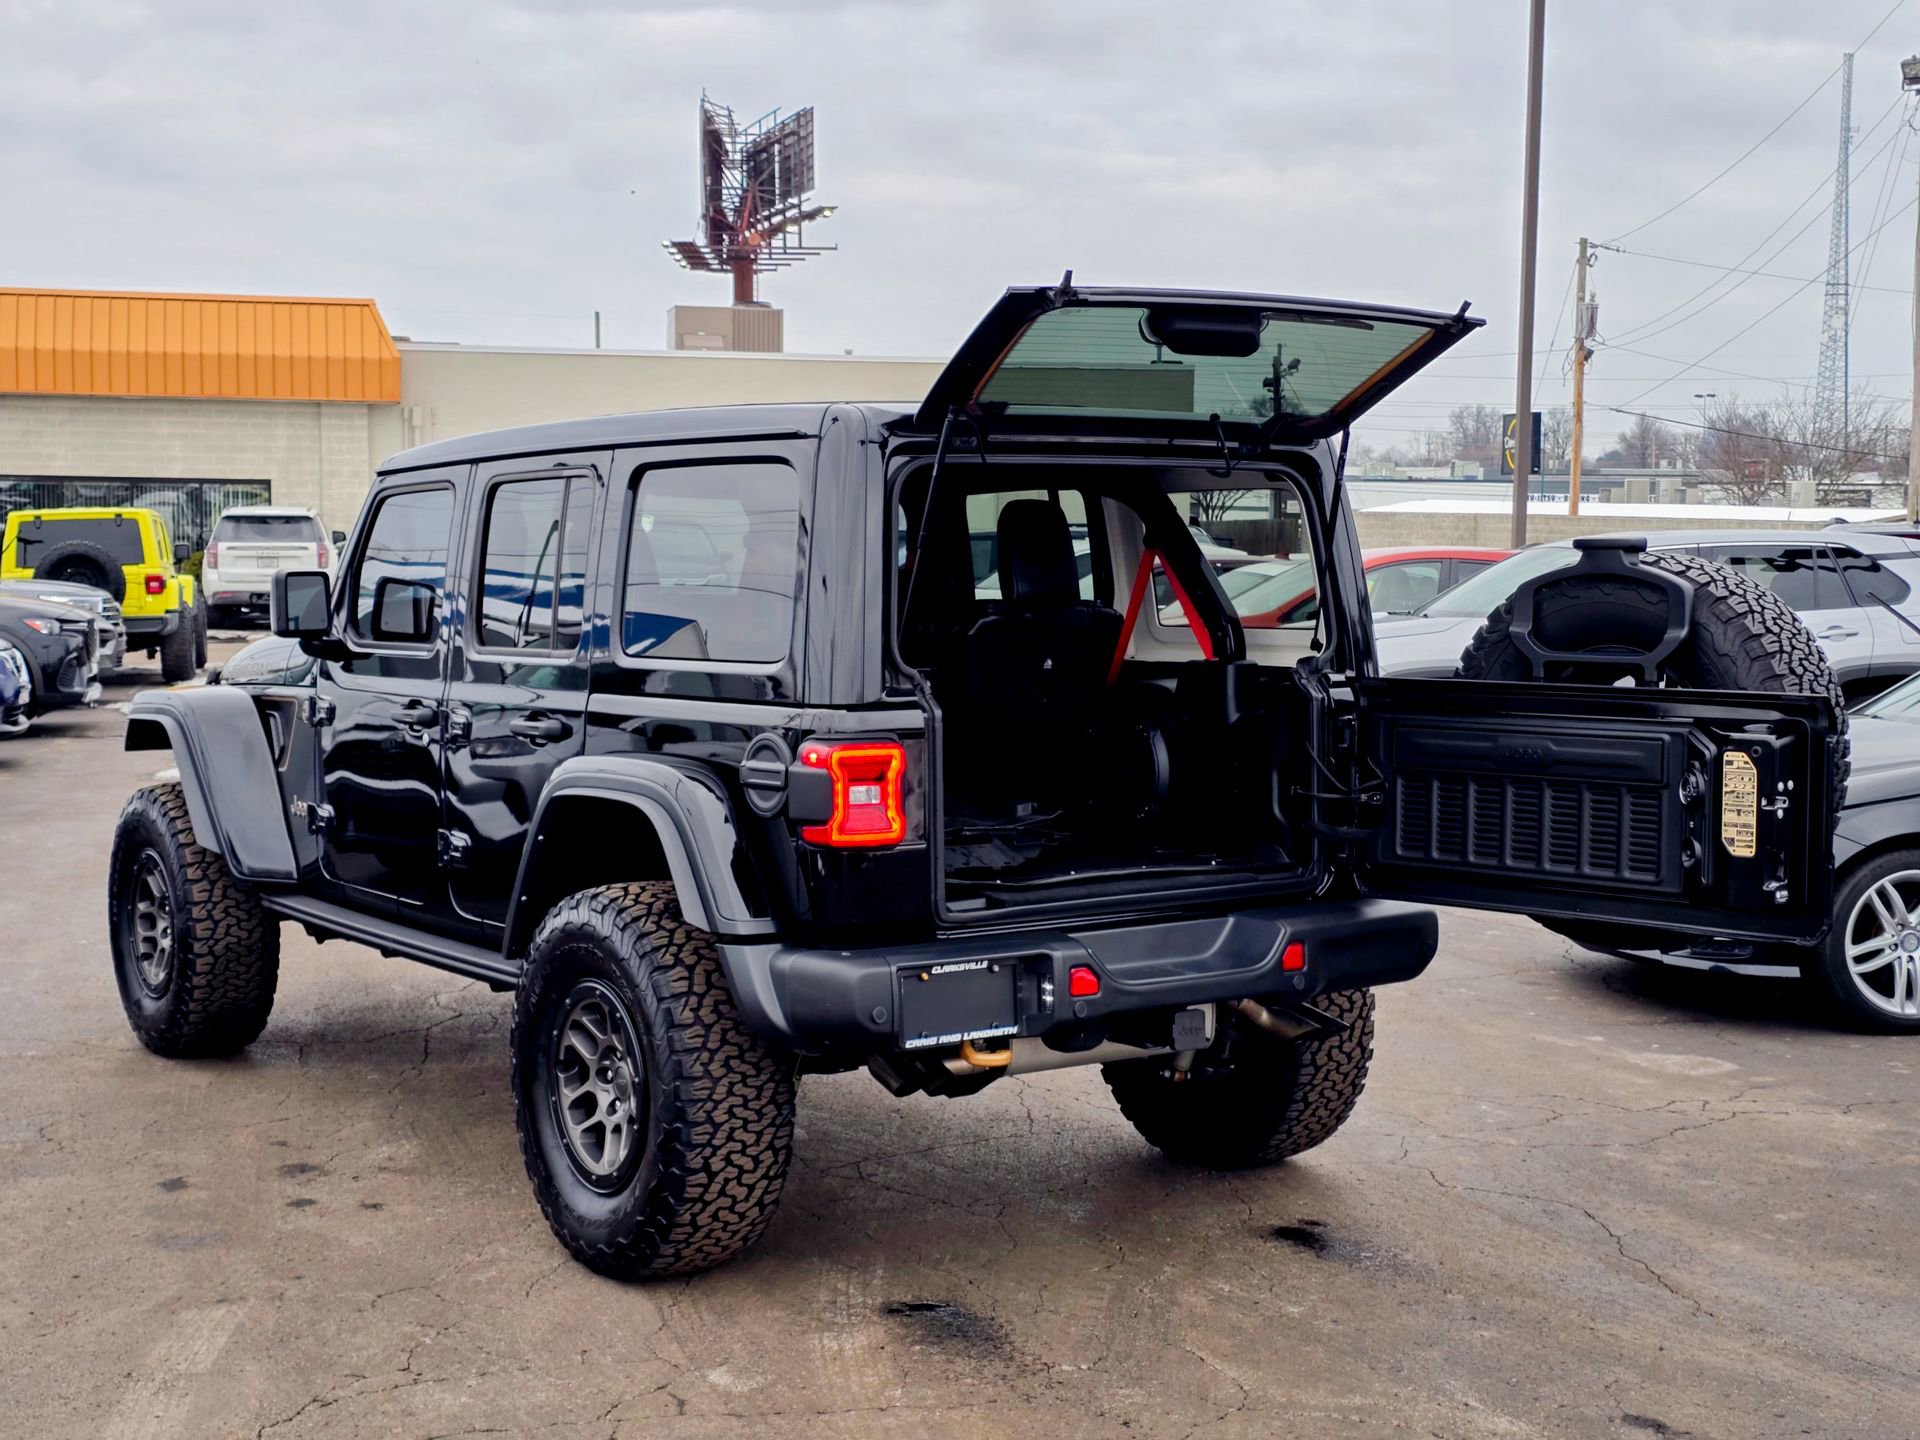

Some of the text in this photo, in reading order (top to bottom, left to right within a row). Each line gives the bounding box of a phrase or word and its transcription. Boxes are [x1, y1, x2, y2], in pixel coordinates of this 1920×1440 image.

[931, 960, 988, 974] CLARKSVILLE
[905, 1026, 1018, 1049] CRAIG AND LANDRETH
